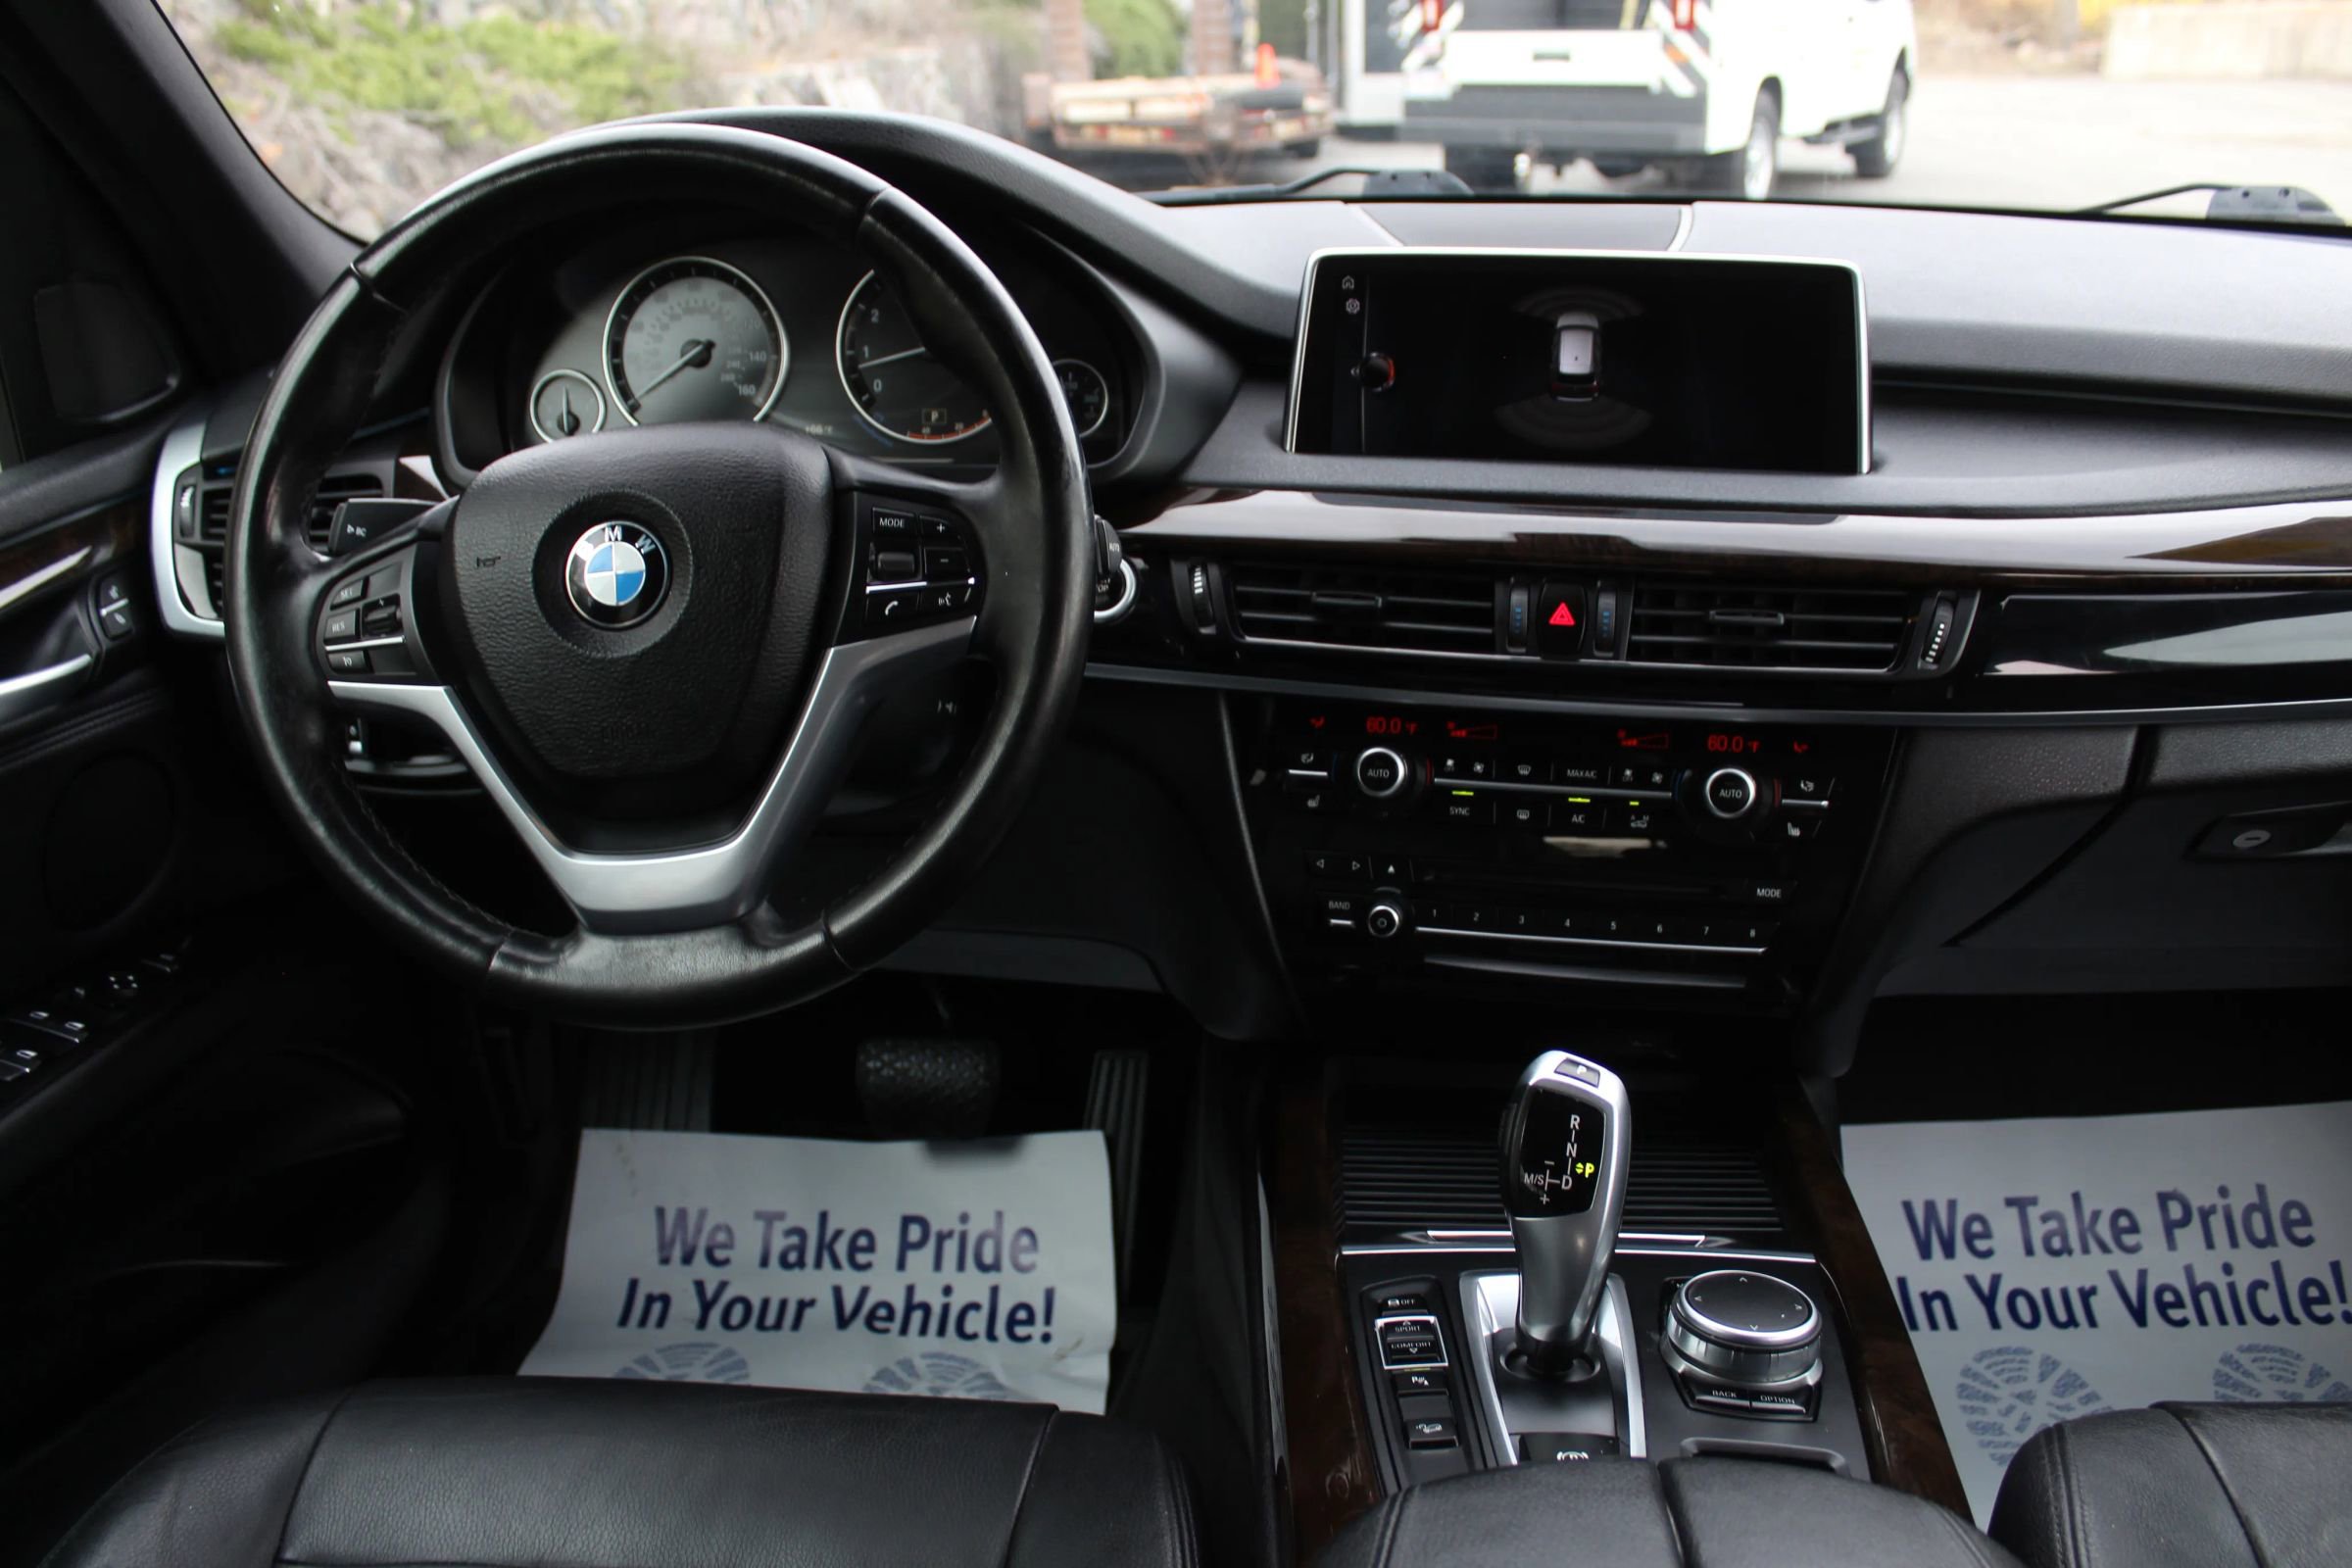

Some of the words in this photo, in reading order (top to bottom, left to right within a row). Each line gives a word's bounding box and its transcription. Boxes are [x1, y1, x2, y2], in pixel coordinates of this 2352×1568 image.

[870, 309, 880, 323] 2
[749, 351, 767, 363] 140
[873, 379, 883, 393] 0
[878, 516, 906, 529] MODE
[1367, 768, 1390, 778] AUTO
[1719, 788, 1742, 799] AUTO
[1449, 806, 1470, 816] SYNC
[1756, 887, 1783, 899] MODE
[1328, 900, 1351, 910] BAND
[1473, 911, 1480, 921] 2
[1519, 915, 1525, 925] 3
[1610, 921, 1617, 931] 5
[1656, 924, 1663, 934] 6
[1703, 926, 1709, 936] 7
[1570, 1114, 1581, 1130] R
[1566, 1142, 1578, 1157] N
[1585, 1162, 1595, 1179] P
[1524, 1172, 1544, 1186] M/S
[1561, 1174, 1573, 1191] D
[1900, 1198, 1996, 1262] We
[2004, 1190, 2142, 1257] Take
[2156, 1182, 2317, 1252] Pride
[654, 1205, 736, 1268] We
[754, 1209, 877, 1273] Take
[895, 1209, 1040, 1274] Pride
[1896, 1275, 1959, 1333] In
[1964, 1273, 2099, 1333] Your
[2107, 1258, 2352, 1330] Vehicle!
[615, 1278, 672, 1331] In
[692, 1279, 815, 1334] Your
[830, 1283, 1056, 1345] Vehicle!
[1395, 1324, 1421, 1333] SPORT
[1390, 1341, 1432, 1350] COMFORT
[1711, 1390, 1738, 1398] BACK
[1760, 1395, 1795, 1404] OPTION
